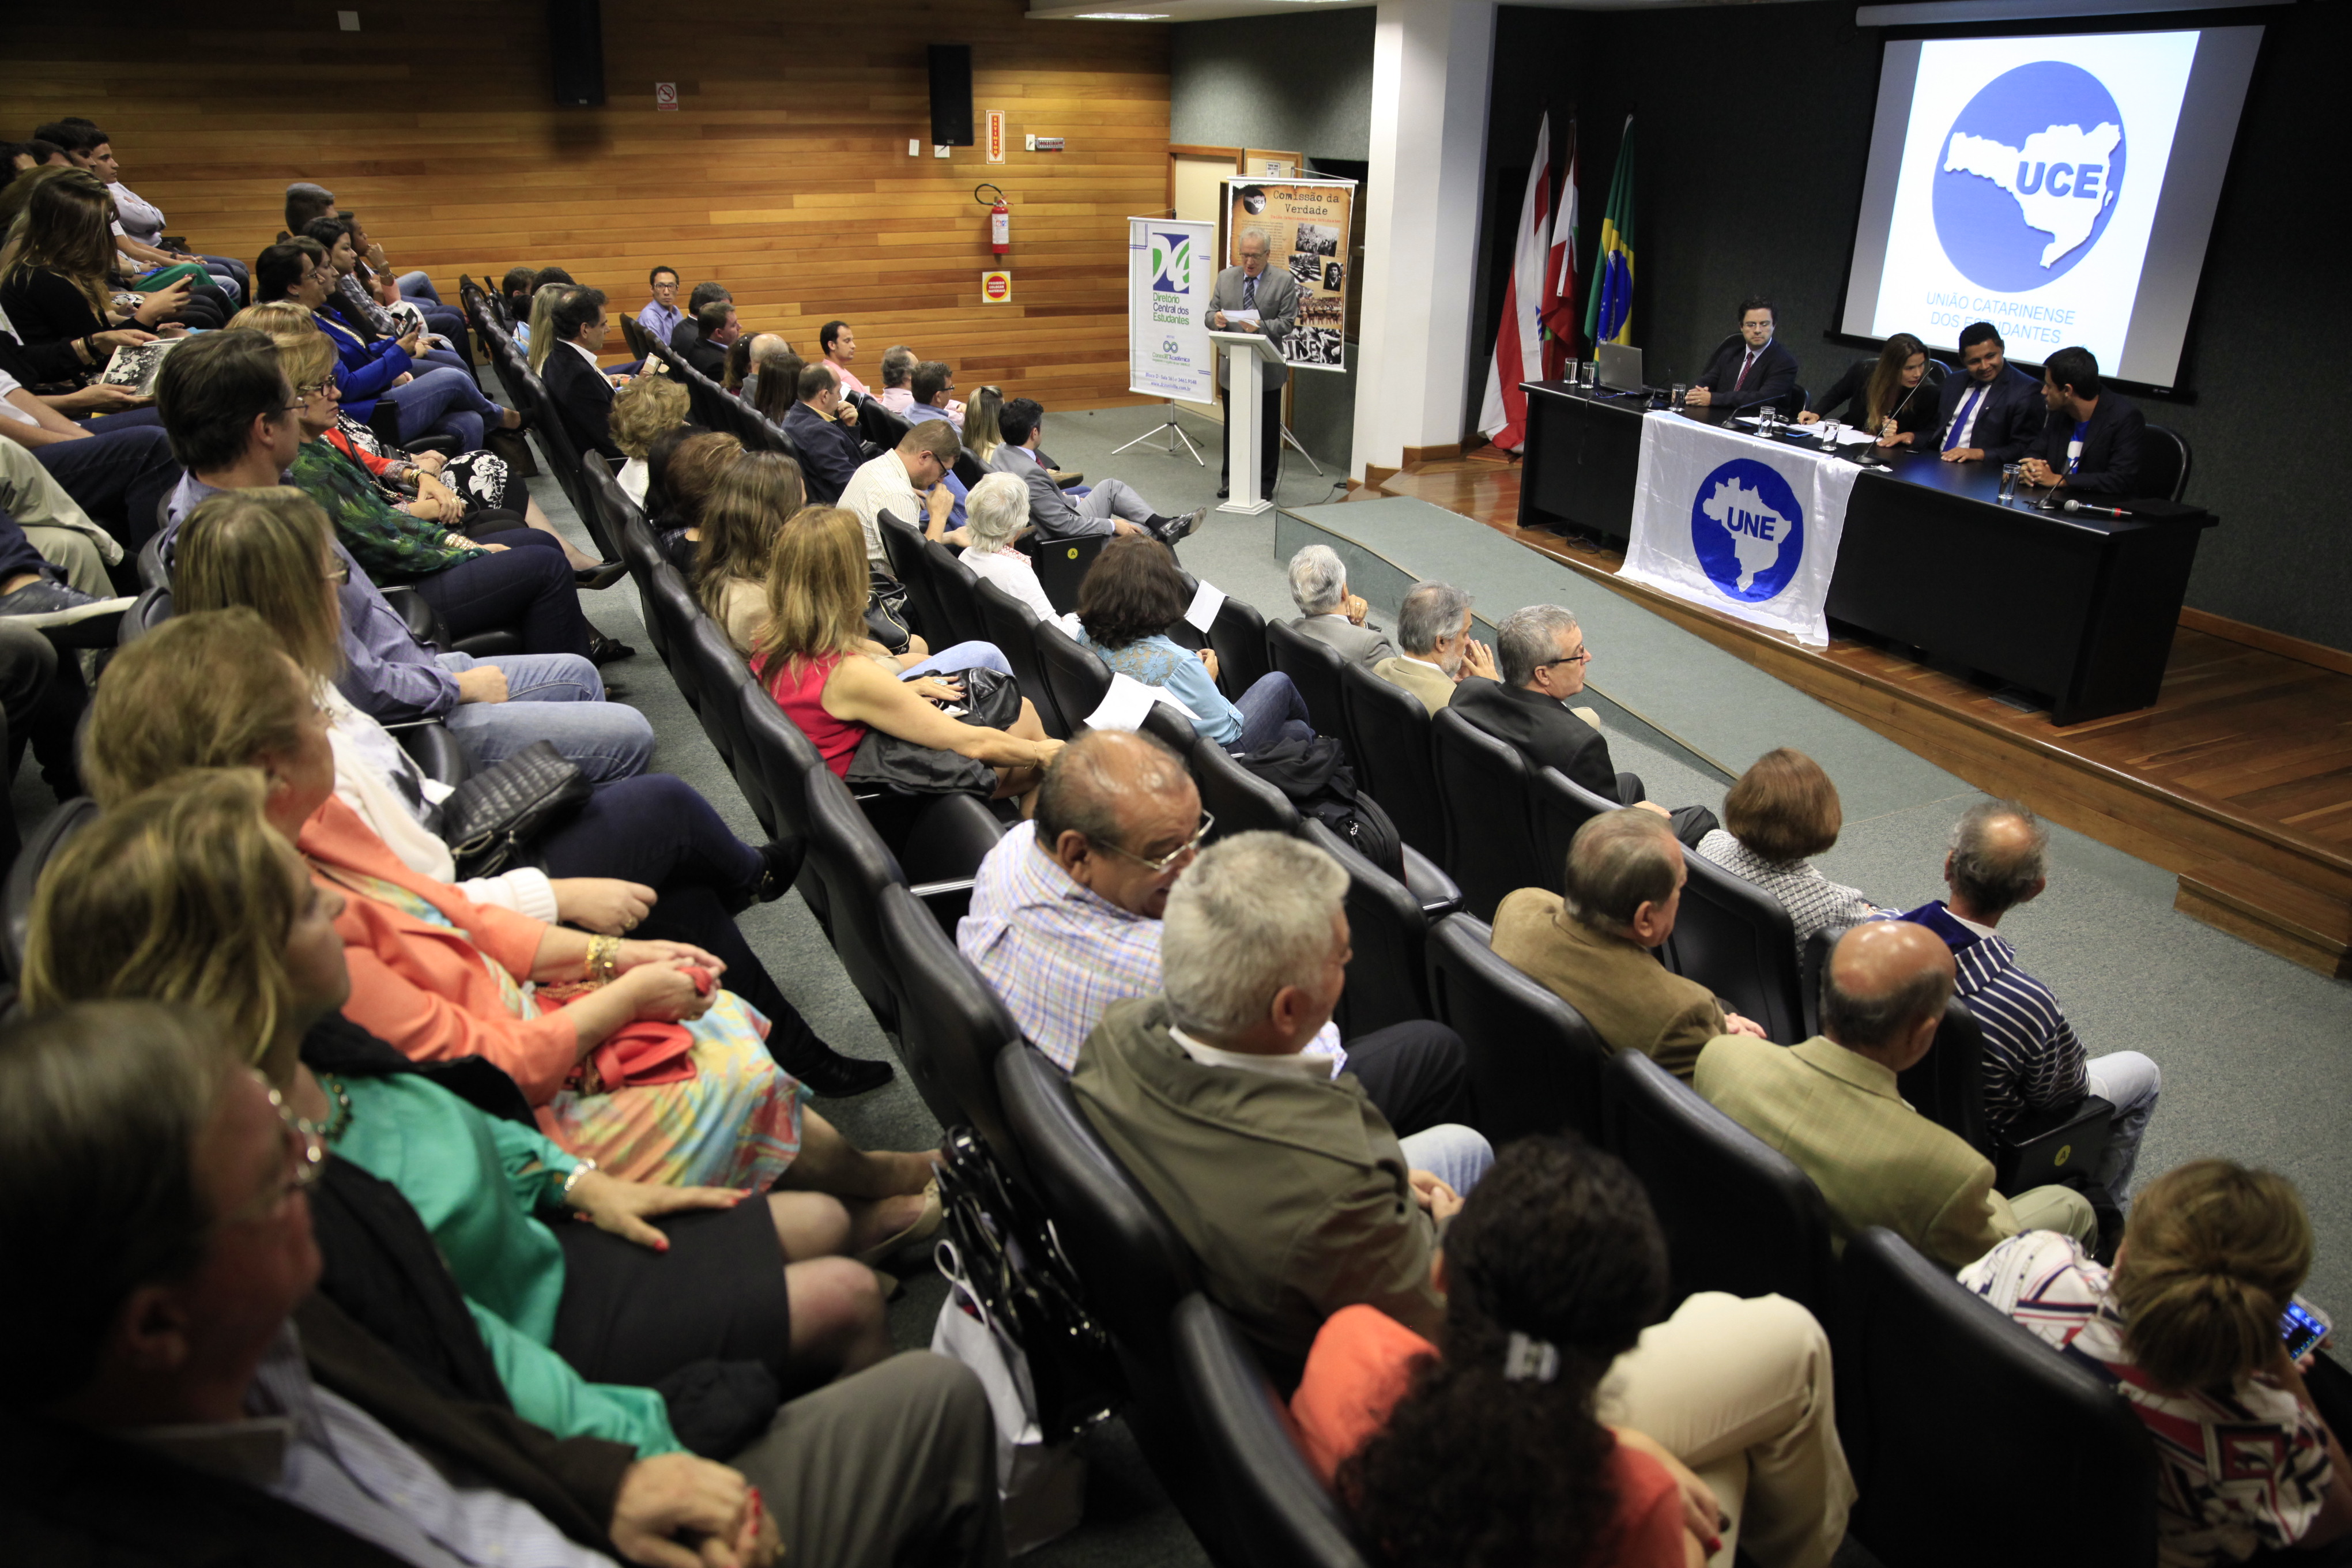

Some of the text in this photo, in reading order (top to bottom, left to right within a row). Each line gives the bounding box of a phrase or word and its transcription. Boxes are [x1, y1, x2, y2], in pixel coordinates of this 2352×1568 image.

[2016, 161, 2103, 199] UCE
[1273, 190, 1339, 203] Comissão da
[1285, 203, 1328, 215] Verdade
[1153, 292, 1180, 304] Diretório
[1153, 302, 1189, 315] Central dos
[1927, 292, 2075, 325] UNIÃO CATARINENSE
[1153, 312, 1189, 325] Estudantes
[1931, 311, 2061, 344] DOS EUDANTES
[1727, 506, 1777, 541] UNE
[2058, 1150, 2066, 1162] A
